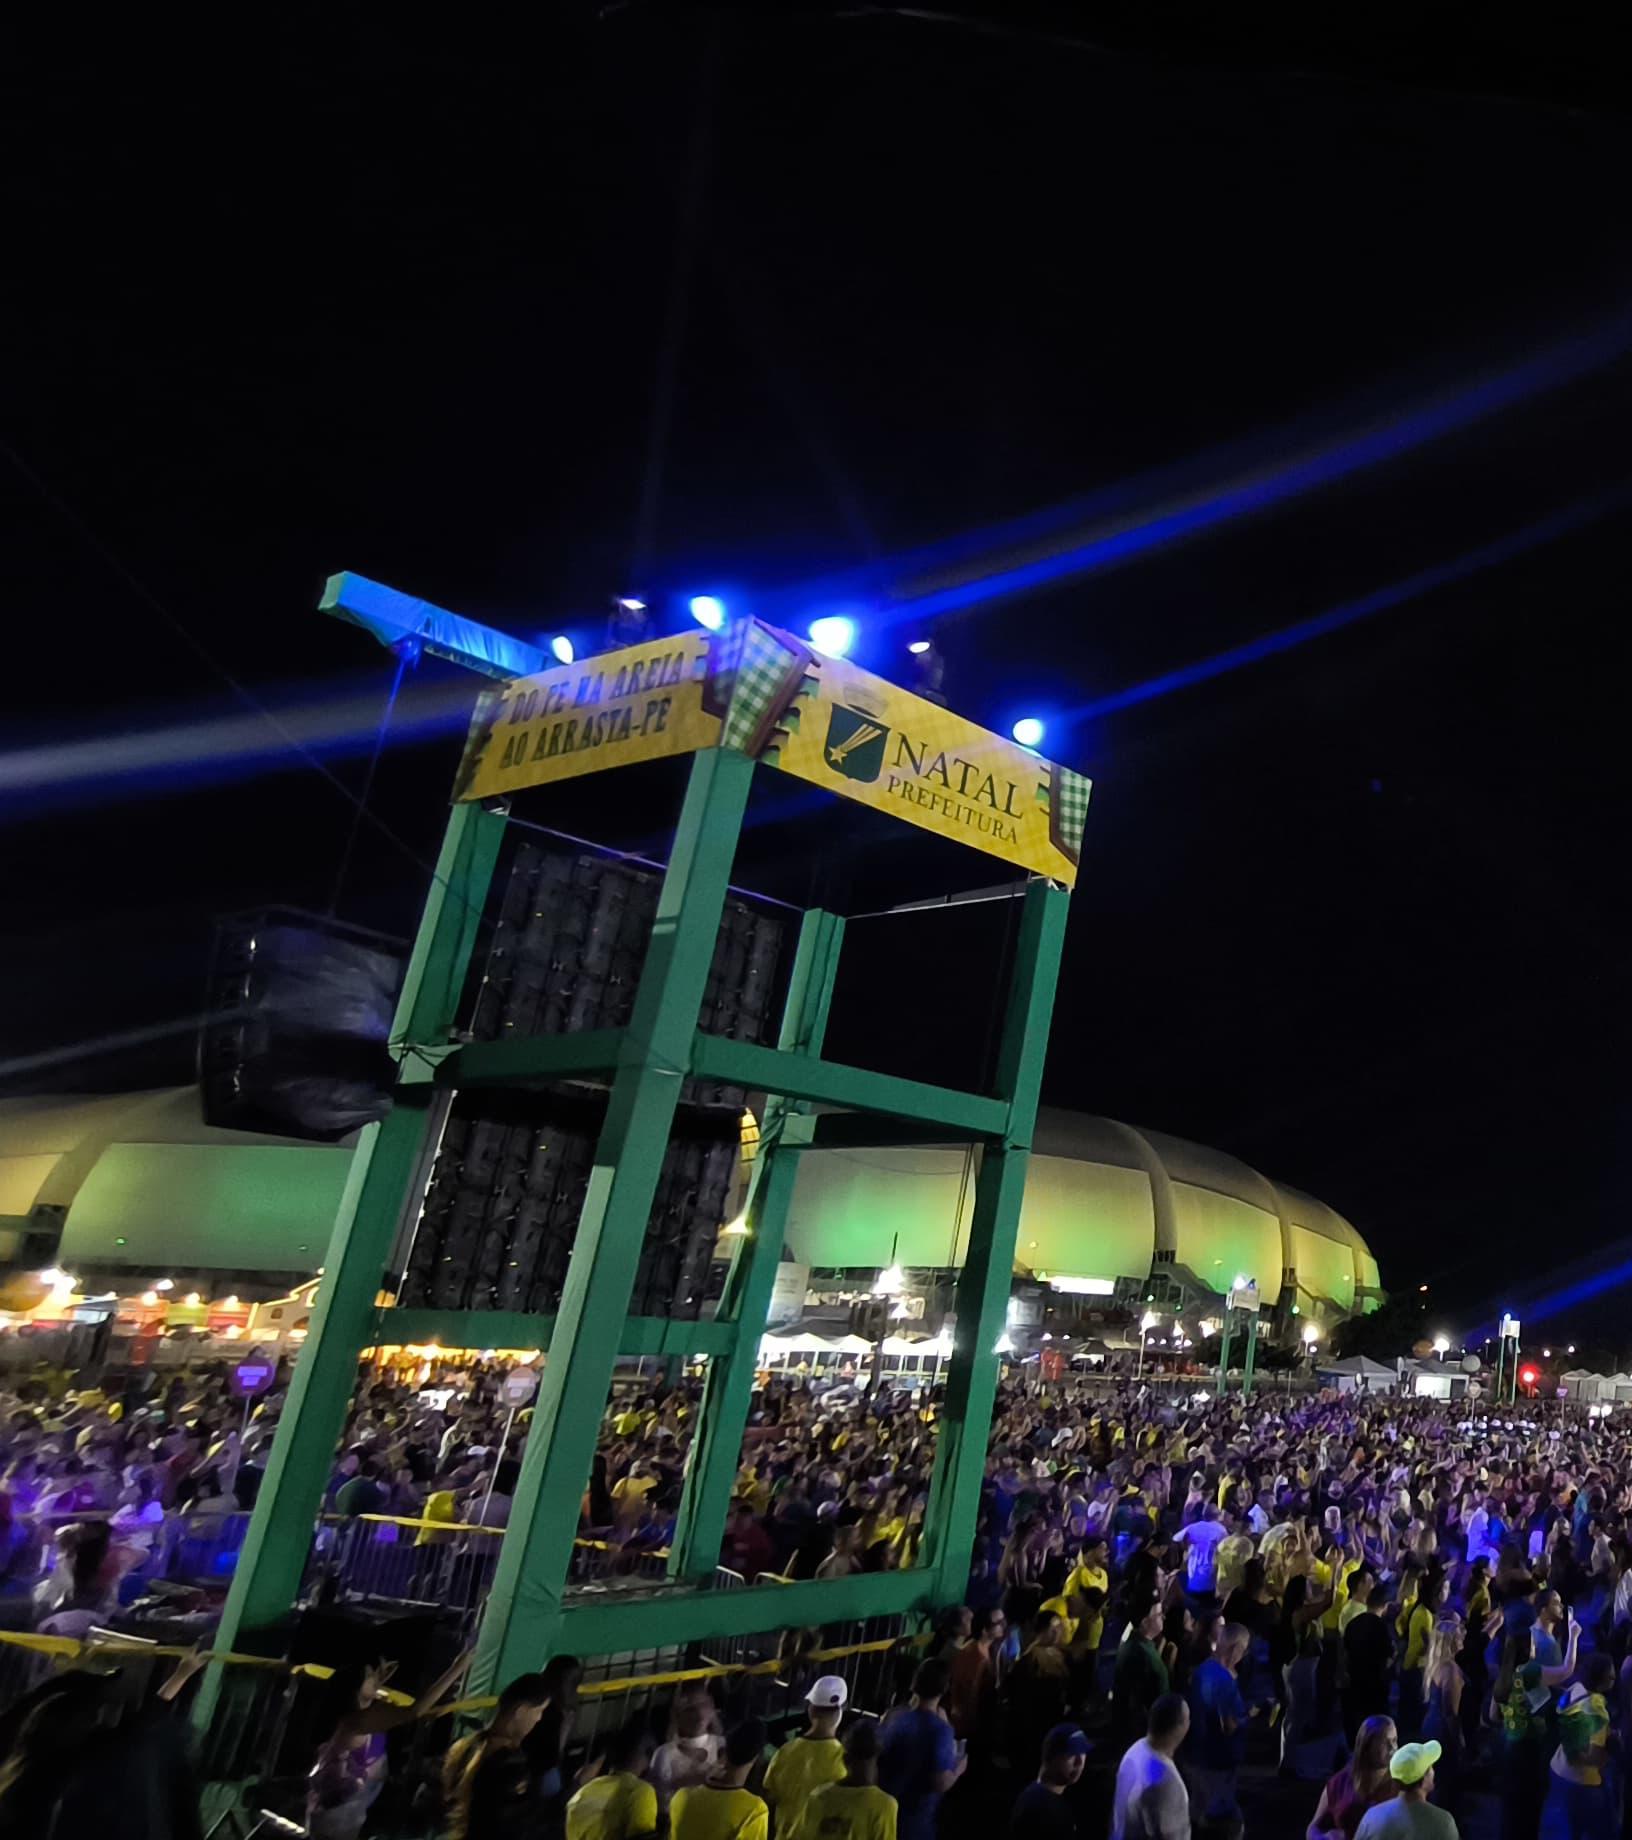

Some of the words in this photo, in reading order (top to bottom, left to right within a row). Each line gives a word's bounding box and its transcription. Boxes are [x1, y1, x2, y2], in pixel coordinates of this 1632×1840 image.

[509, 690, 539, 725] DO
[608, 651, 685, 700] AREIA
[501, 732, 528, 768] AO
[892, 731, 1024, 820] NATAL
[887, 774, 1018, 845] PREFEITURA
